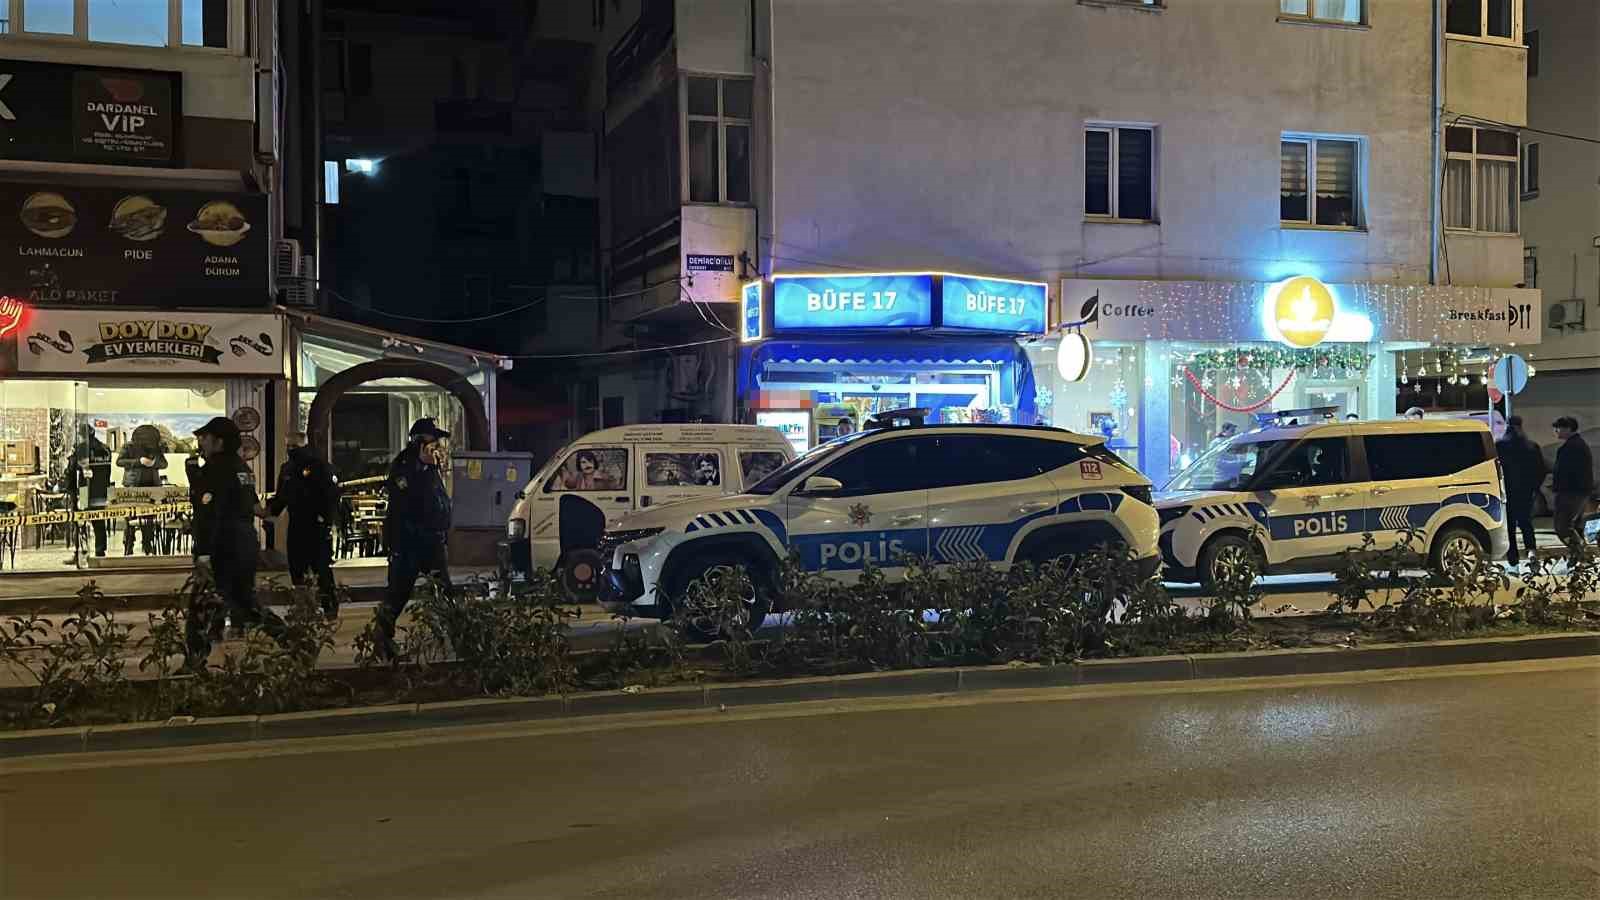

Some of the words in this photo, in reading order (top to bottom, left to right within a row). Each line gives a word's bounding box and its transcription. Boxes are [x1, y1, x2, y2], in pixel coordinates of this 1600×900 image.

[87, 102, 158, 116] DARDANEL
[19, 246, 84, 257] LAHMACUN
[204, 255, 238, 264] ADANA
[807, 288, 866, 312] BÜFE
[872, 290, 897, 310] 17
[966, 290, 1006, 314] BÜFE
[1008, 297, 1025, 316] 17
[1102, 303, 1154, 318] Coffee
[1450, 308, 1506, 321] Breakfast
[99, 320, 154, 339] DOY
[158, 320, 211, 340] DOY
[105, 343, 123, 356] EV
[1081, 462, 1099, 473] 112
[1294, 511, 1348, 536] POLİS
[820, 532, 905, 565] POLİS
